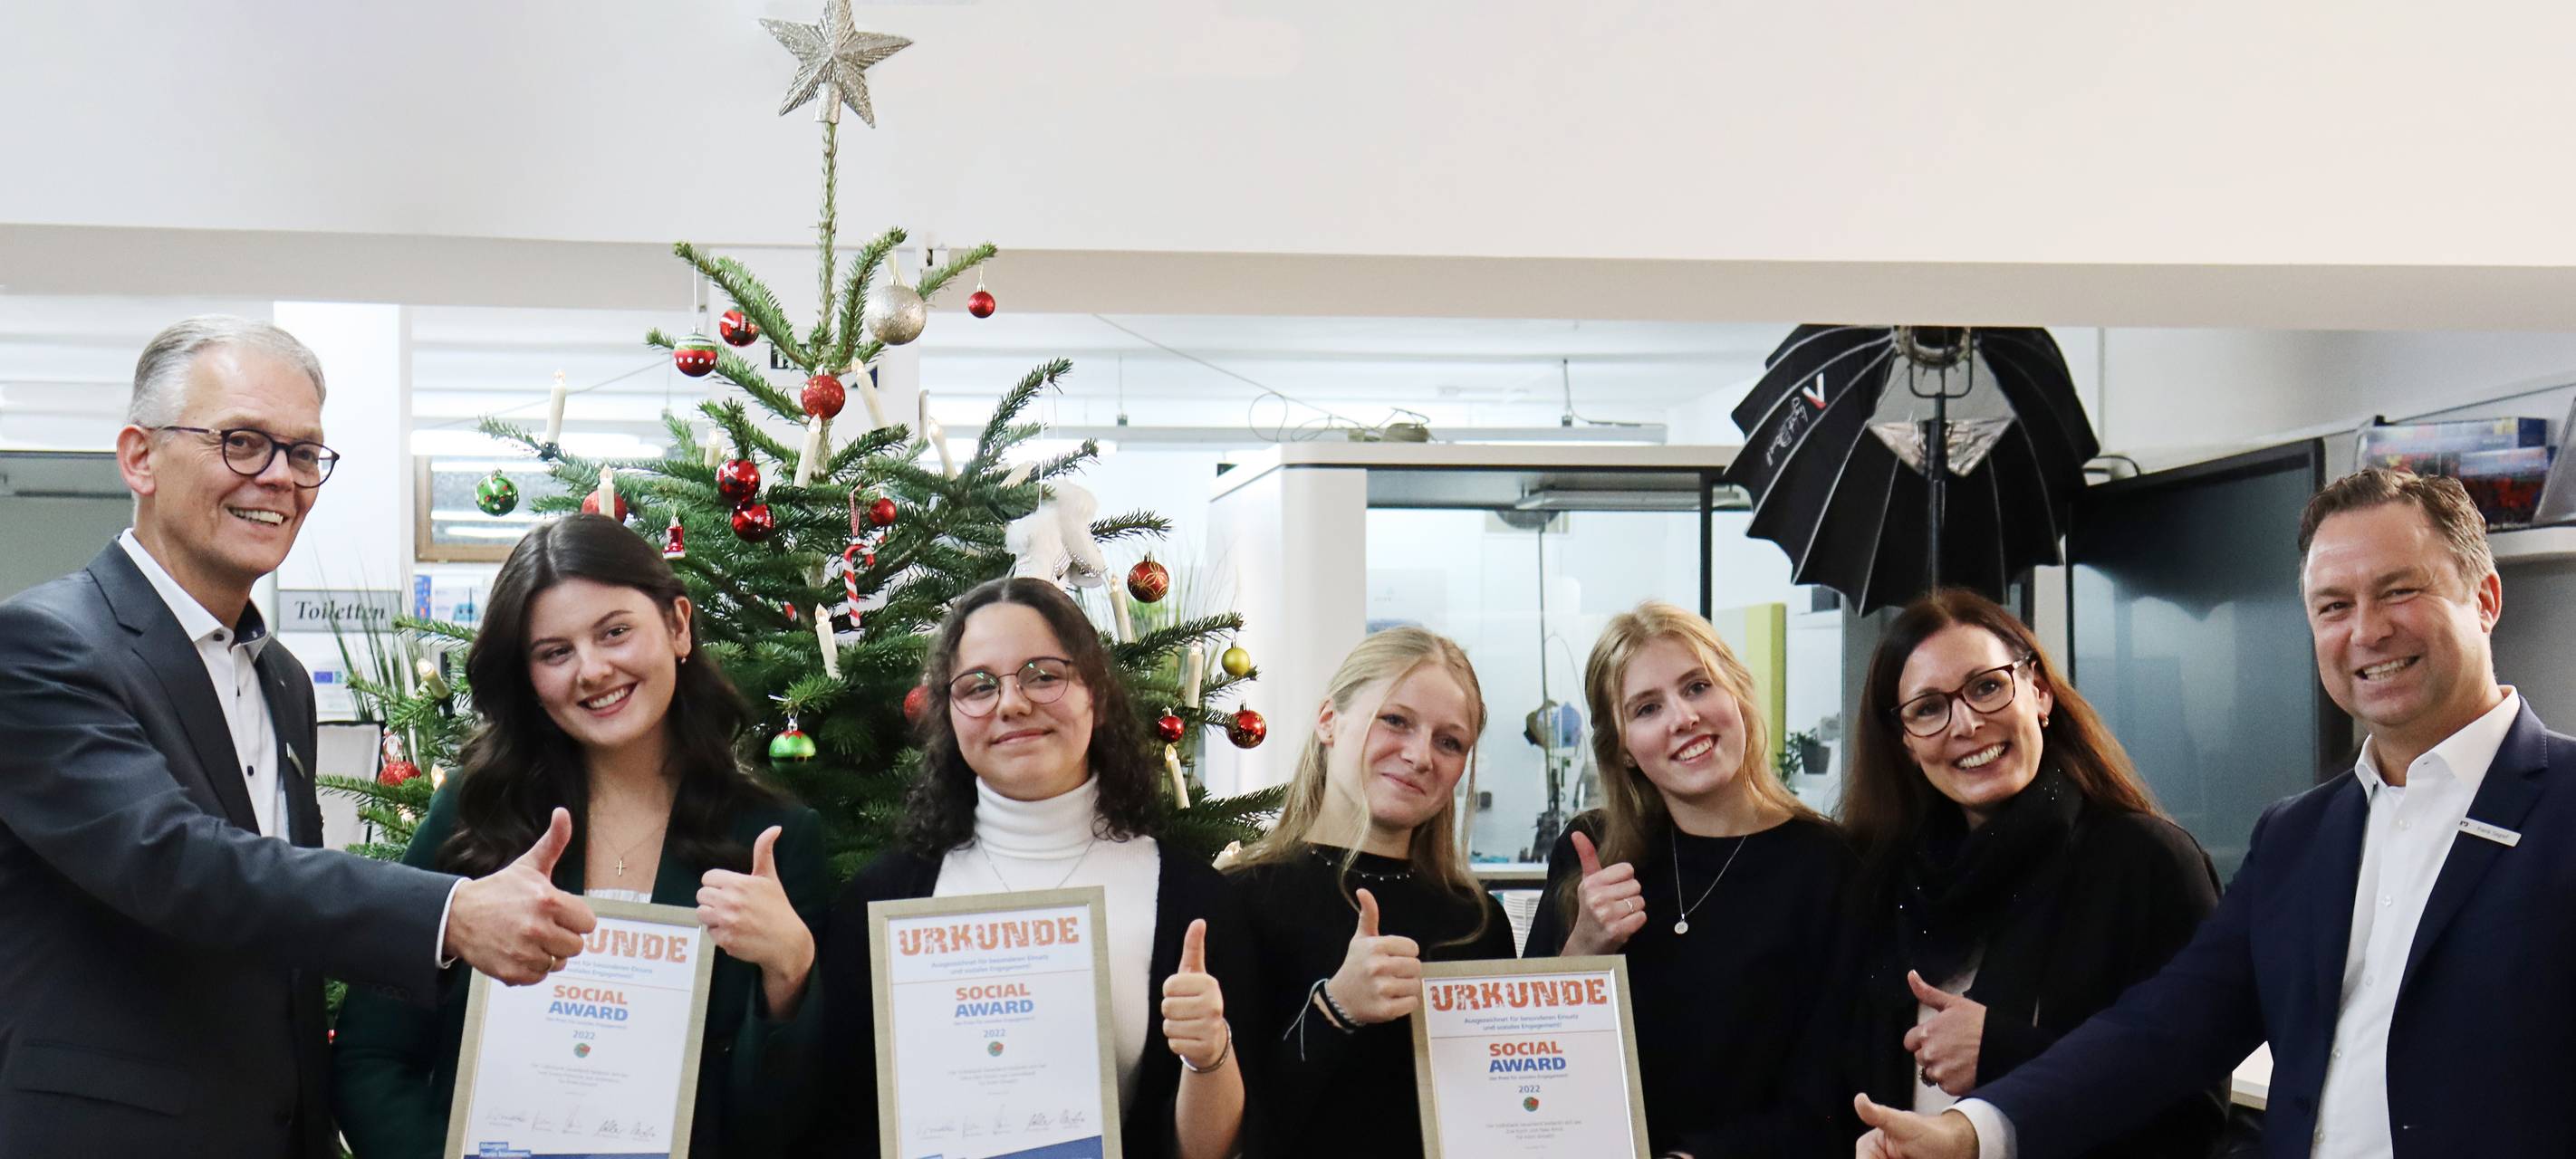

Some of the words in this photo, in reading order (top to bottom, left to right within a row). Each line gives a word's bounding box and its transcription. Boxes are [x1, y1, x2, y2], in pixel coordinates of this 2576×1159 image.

[899, 916, 1080, 956] URKUNDE
[585, 928, 687, 963] UNDE
[553, 985, 628, 1005] SOCIAL
[956, 983, 1031, 1001] SOCIAL
[1430, 979, 1607, 1012] URKUNDE
[548, 1001, 629, 1021] AWARD
[955, 1000, 1033, 1018] AWARD
[1465, 1017, 1508, 1025] Ausgezeichnet
[572, 1030, 595, 1040] 2022
[984, 1029, 1006, 1039] 2022
[1489, 1041, 1562, 1057] SOCIAL
[1489, 1057, 1566, 1073] AWARD
[1518, 1085, 1541, 1094] 2022
